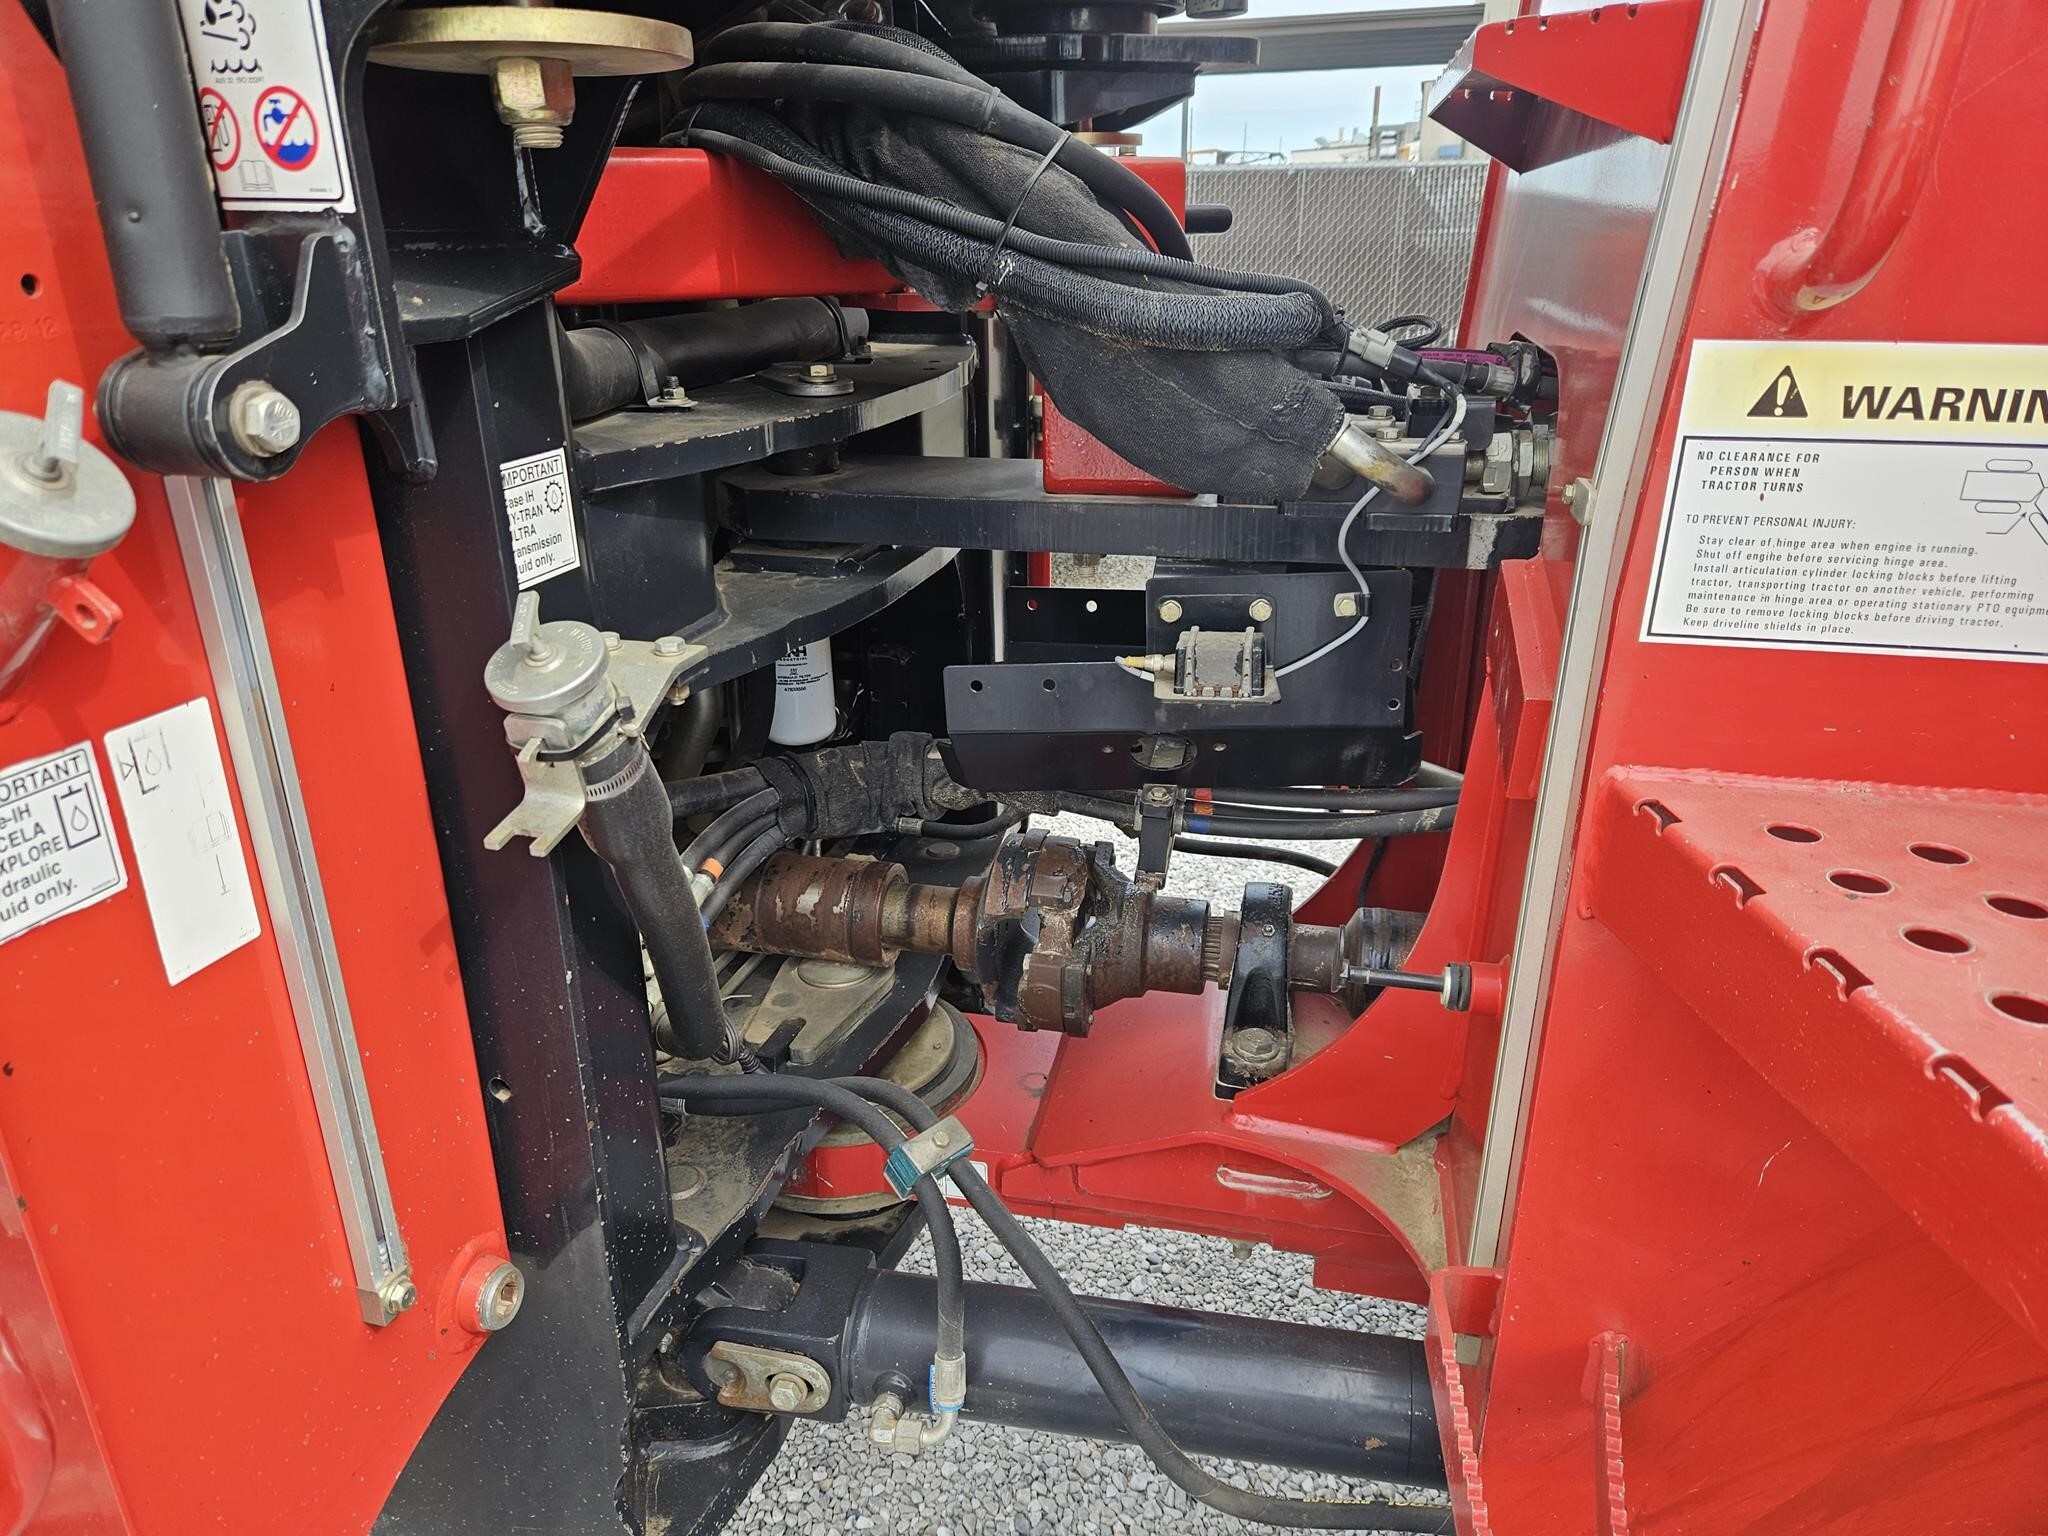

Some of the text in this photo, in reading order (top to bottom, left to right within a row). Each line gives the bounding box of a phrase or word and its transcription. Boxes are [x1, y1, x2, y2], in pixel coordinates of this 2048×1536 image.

[1697, 451, 1820, 463] NO CLEARANCE FOR
[1710, 466, 1800, 477] PERSON WHEN
[1701, 480, 1804, 492] TRACTOR TURNS
[509, 490, 535, 508] ase IH
[511, 504, 543, 524] Y-TRAN
[1686, 514, 1856, 529] TO PREVENT PERSONAL INJURY:
[514, 524, 537, 541] LTRA
[516, 533, 562, 558] ansmission
[1699, 535, 1978, 556] Stay clear of hinge area when engine is running.
[519, 558, 533, 574] uid
[535, 552, 556, 567] only.
[1696, 549, 1948, 568] Shut off engine before servicing hinge area.
[1693, 563, 2017, 587] Install articulation cylinder locking blocks before lifting
[1691, 577, 2034, 602] tractor, transporting tractor on another vehicle, performing
[1688, 592, 1755, 603] maintenance
[1761, 593, 1769, 603] in
[1774, 594, 1803, 605] hinge
[1809, 597, 1832, 606] area
[1837, 598, 1848, 606] or
[1853, 598, 1907, 610] operating
[1912, 601, 1971, 613] stationary
[1976, 603, 2000, 613] PTO
[1683, 617, 1854, 634] Keep driveline shields in place.
[1686, 604, 2004, 628] Be sure to remove locking blocks before driving tractor.
[2, 862, 62, 898] draulic
[0, 896, 29, 922] uid
[35, 878, 78, 905] only.
